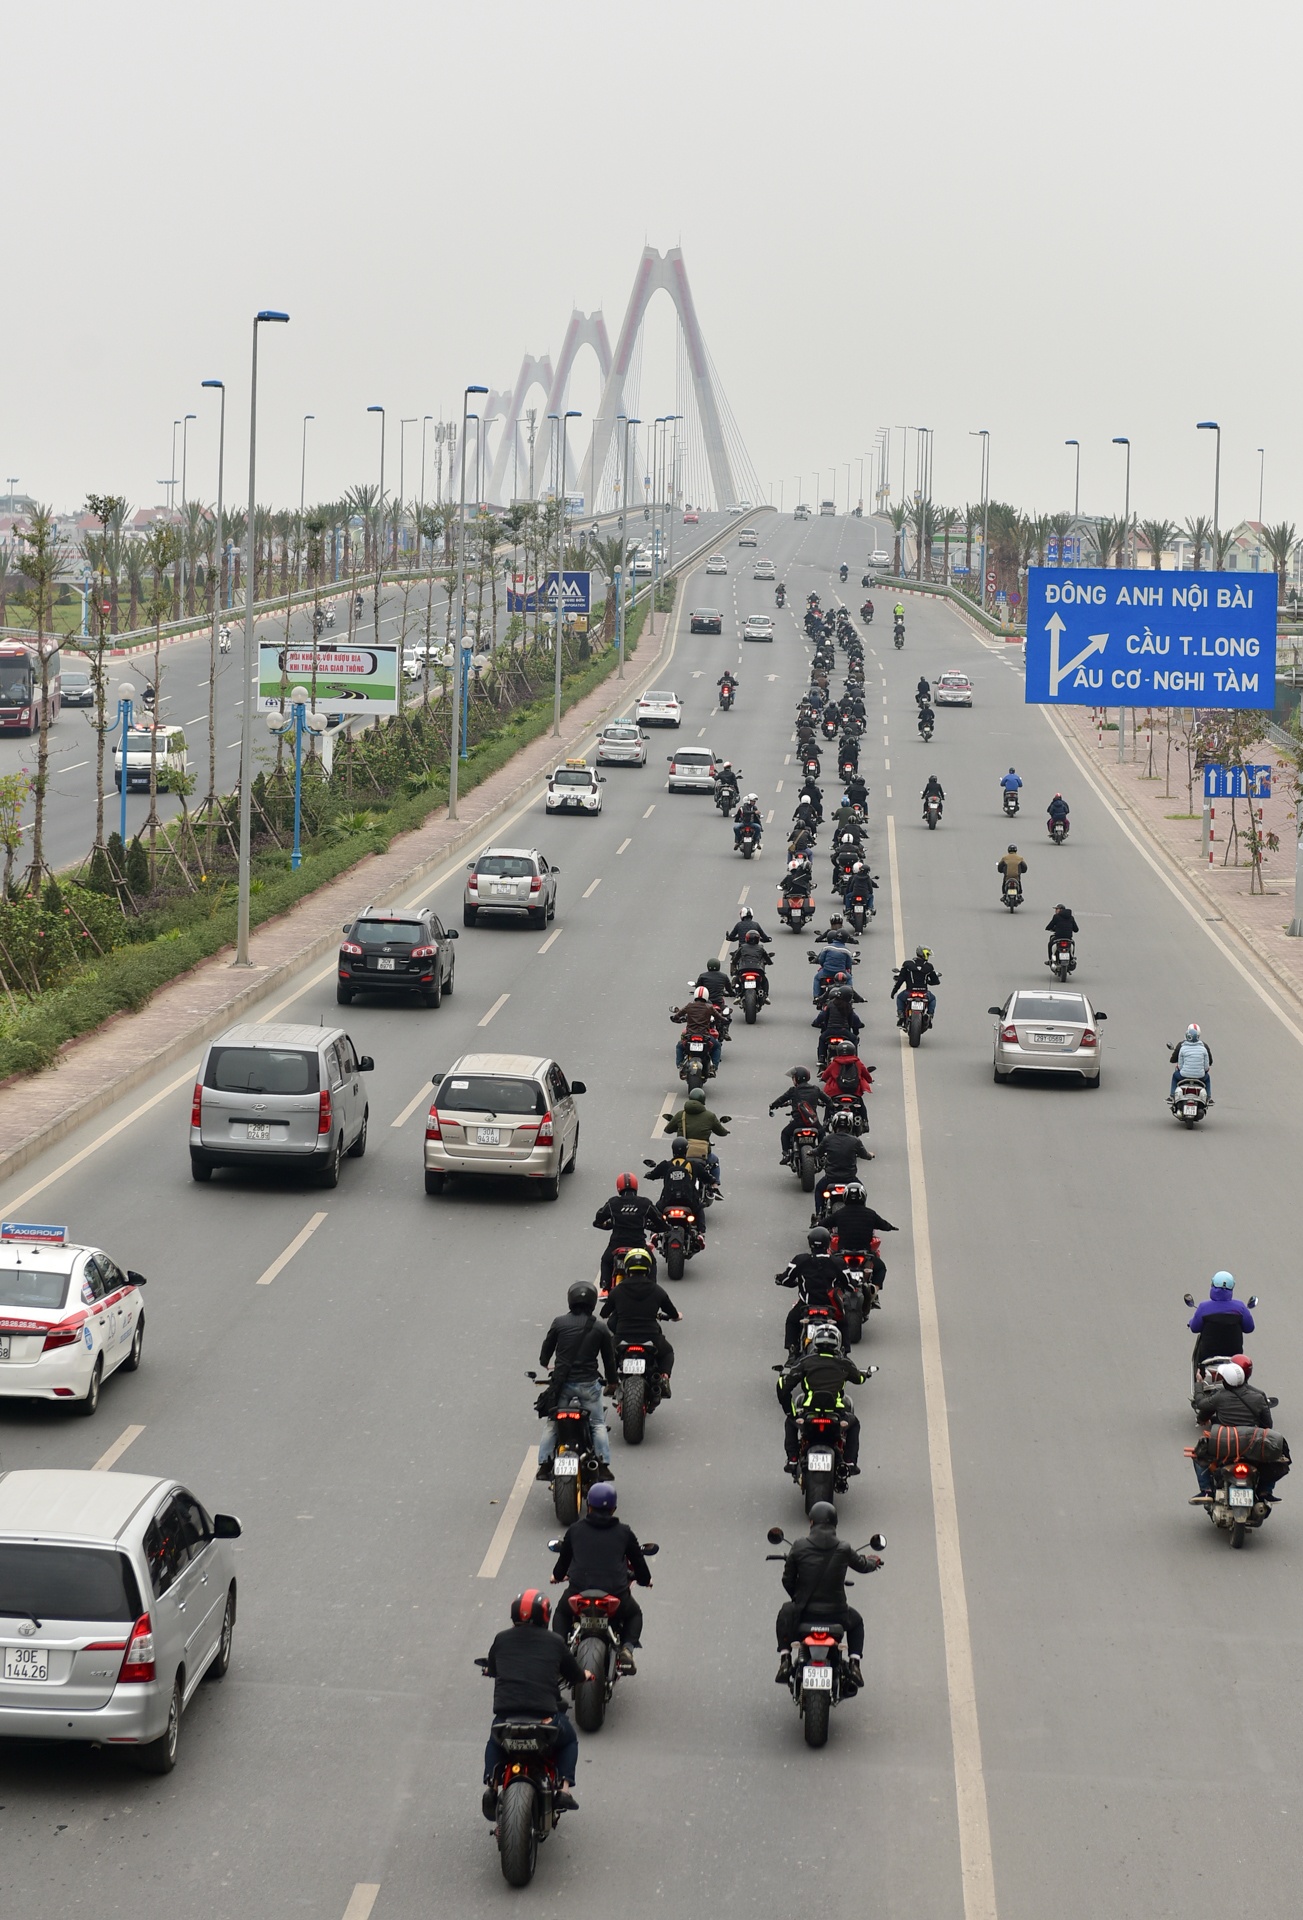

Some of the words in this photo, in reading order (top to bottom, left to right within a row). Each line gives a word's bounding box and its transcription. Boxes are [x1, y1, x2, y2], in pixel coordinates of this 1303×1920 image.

[1045, 580, 1106, 604] ĐÔNG
[1116, 586, 1163, 606] ANH
[1172, 584, 1208, 612] NỘI
[1217, 584, 1253, 608] BÀI
[1126, 626, 1170, 655] CẦU
[1073, 664, 1103, 688] ÂU
[1111, 668, 1142, 690] CƠ
[1153, 670, 1204, 691] NGHI
[1213, 667, 1259, 693] TÀM
[482, 1128, 495, 1136] 30A
[10, 1228, 63, 1237] TAXIGROUP
[15, 1649, 39, 1663] 30E
[7, 1663, 46, 1679] 144.26
[804, 1678, 830, 1688] 901.08
